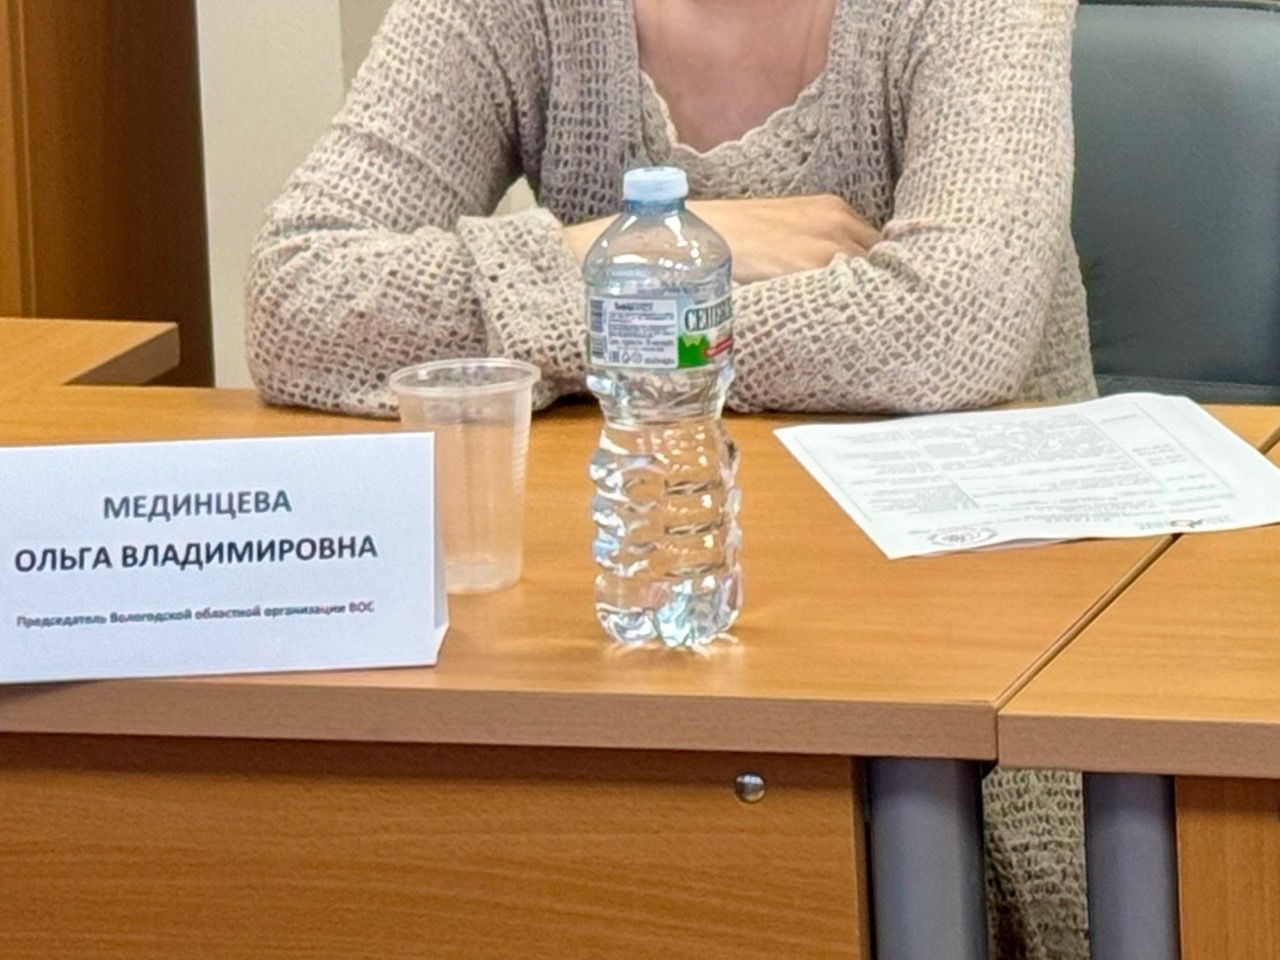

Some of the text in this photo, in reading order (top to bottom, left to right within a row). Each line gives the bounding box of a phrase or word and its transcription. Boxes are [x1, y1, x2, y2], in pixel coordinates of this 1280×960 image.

[103, 490, 293, 523] МЕДИНЦЕВА
[14, 535, 379, 572] ОЛЬГА ВЛАДИМИРОВНА
[16, 600, 376, 629] Председатель Вологодской областной организации ВОС
